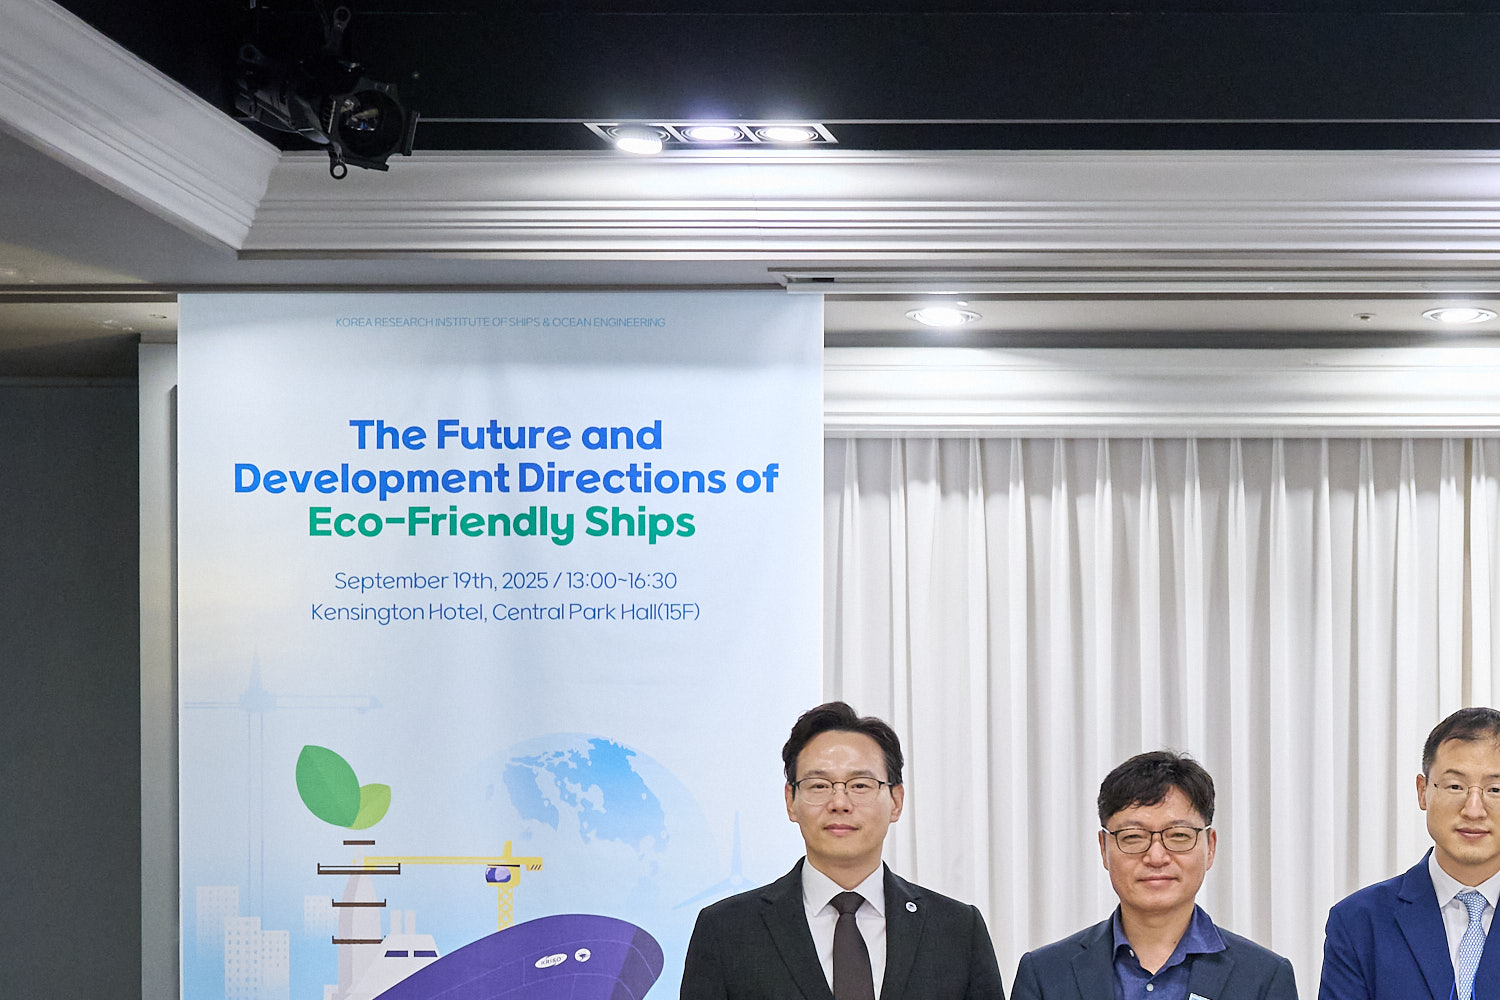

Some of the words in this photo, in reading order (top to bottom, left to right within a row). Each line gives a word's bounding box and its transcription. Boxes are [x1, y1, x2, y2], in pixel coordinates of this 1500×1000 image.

[336, 317, 372, 327] KOREA
[374, 317, 433, 327] RESEARCH
[435, 317, 490, 327] INSTITUTE
[492, 317, 507, 327] OF
[509, 317, 540, 327] SHIPS
[543, 317, 550, 327] &
[552, 317, 592, 327] OCEAN
[594, 317, 666, 327] ENGINEERING
[349, 419, 427, 450] The
[438, 419, 572, 450] Future
[582, 419, 663, 450] and
[234, 462, 510, 501] Development
[519, 462, 727, 494] Directions
[736, 462, 780, 494] of
[309, 505, 574, 547] Eco-Friendly
[585, 505, 696, 545] Ships
[335, 571, 448, 593] September
[453, 571, 498, 592] 19th,
[502, 571, 548, 589] 2025
[566, 571, 678, 589] 13:00~16:30
[311, 602, 424, 626] Kensington
[430, 602, 488, 623] Hotel,
[493, 602, 565, 621] Central
[569, 602, 617, 621] Park
[621, 602, 701, 622] Hall(15F)
